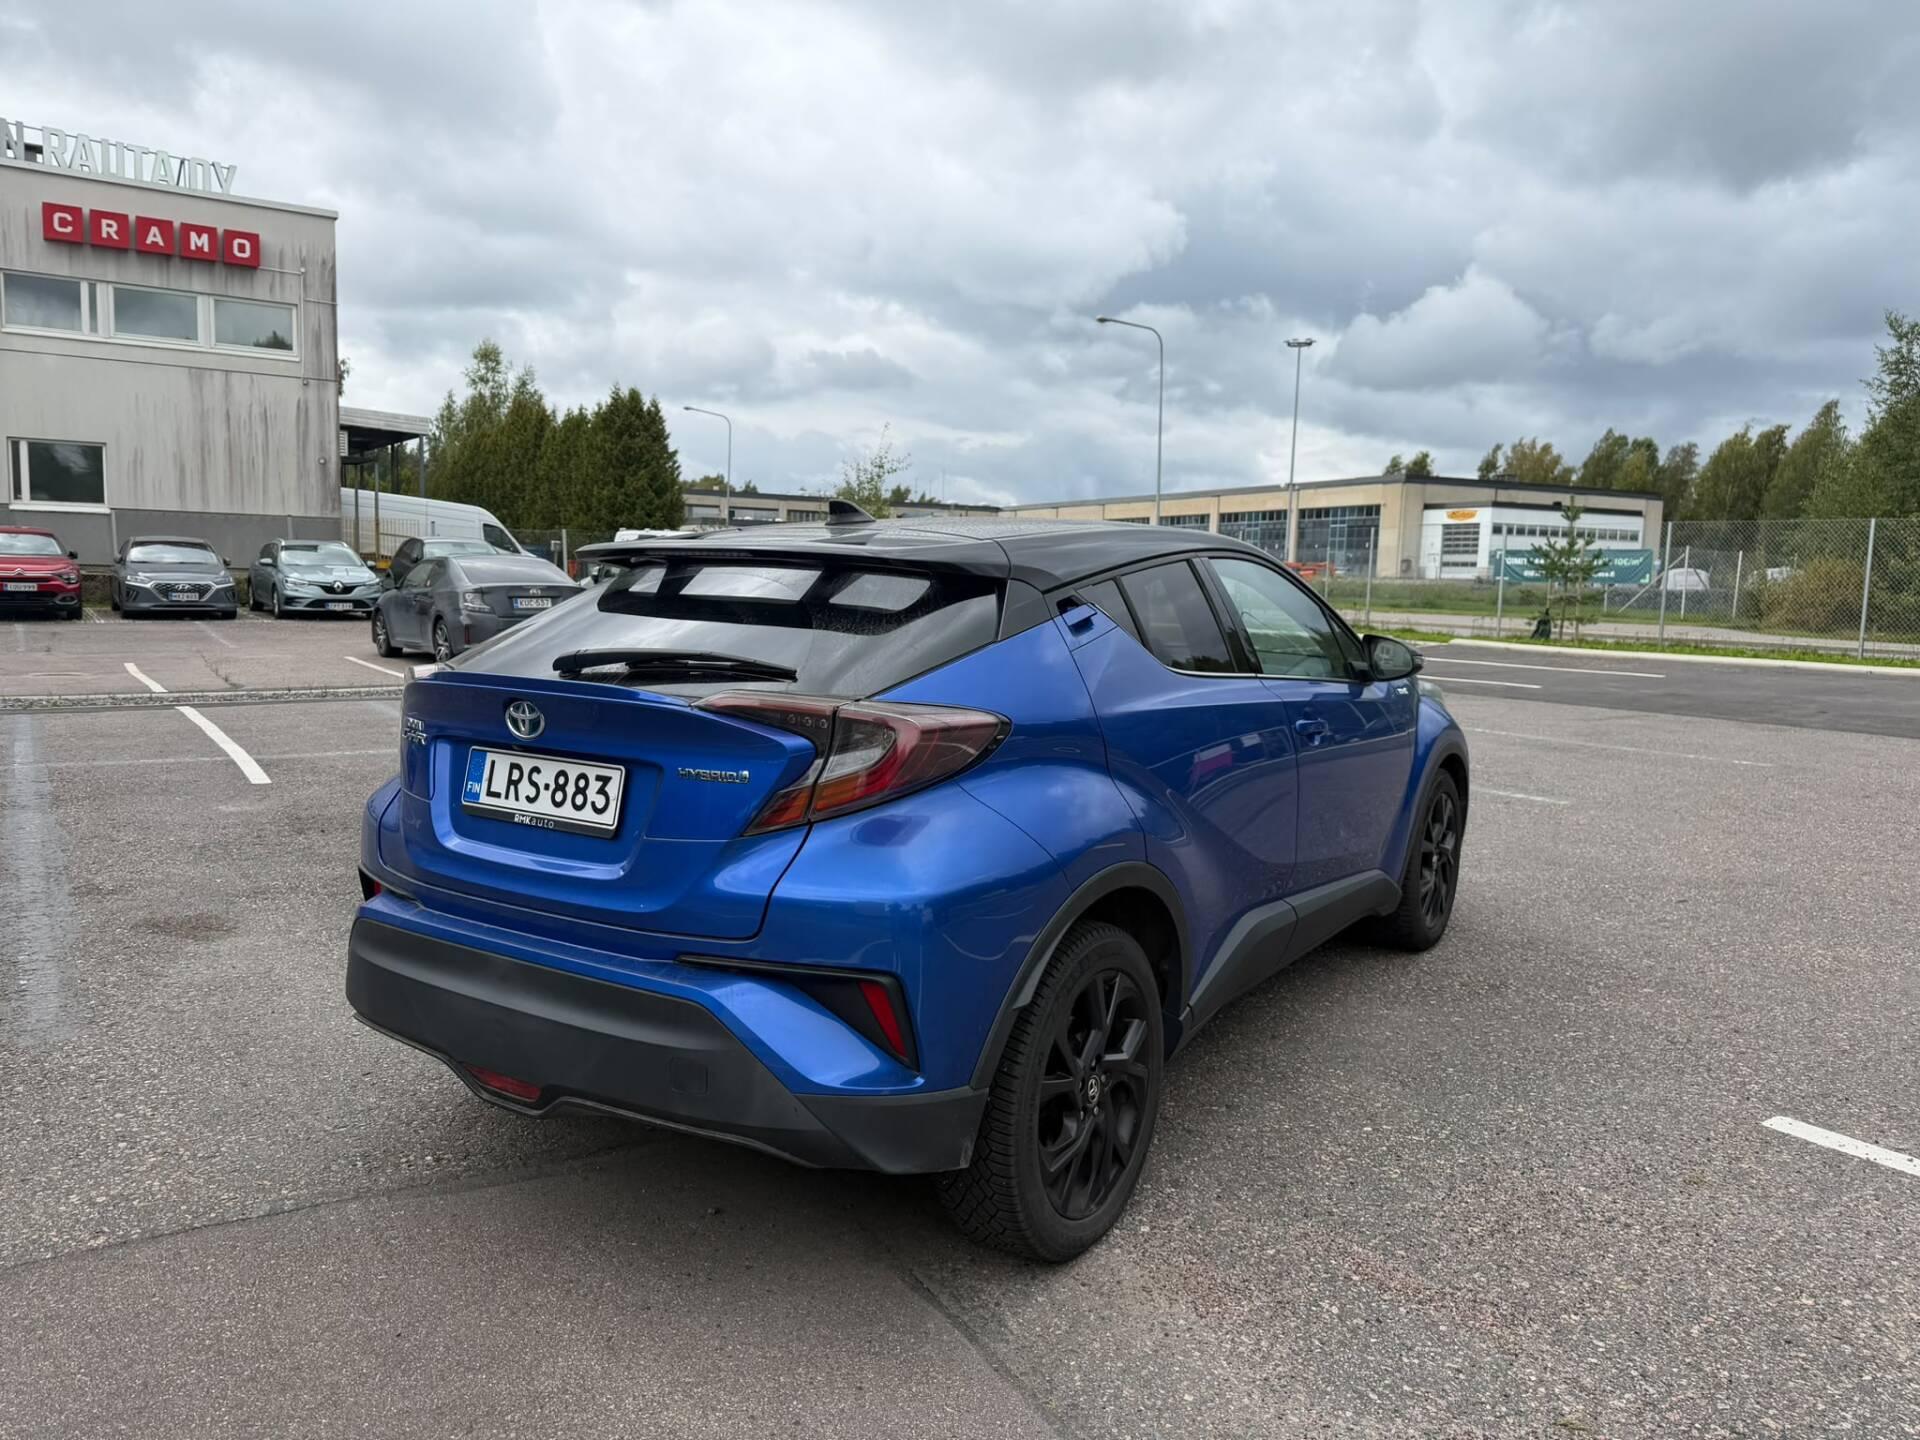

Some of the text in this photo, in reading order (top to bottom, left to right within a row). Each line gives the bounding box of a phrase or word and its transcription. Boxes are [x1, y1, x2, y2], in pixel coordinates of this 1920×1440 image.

[42, 126, 175, 185] RAUTA
[52, 211, 251, 258] CRAMO
[466, 759, 613, 815] FIN LRS-883
[678, 767, 739, 783] HYBRID
[513, 814, 555, 829] RMKauto
